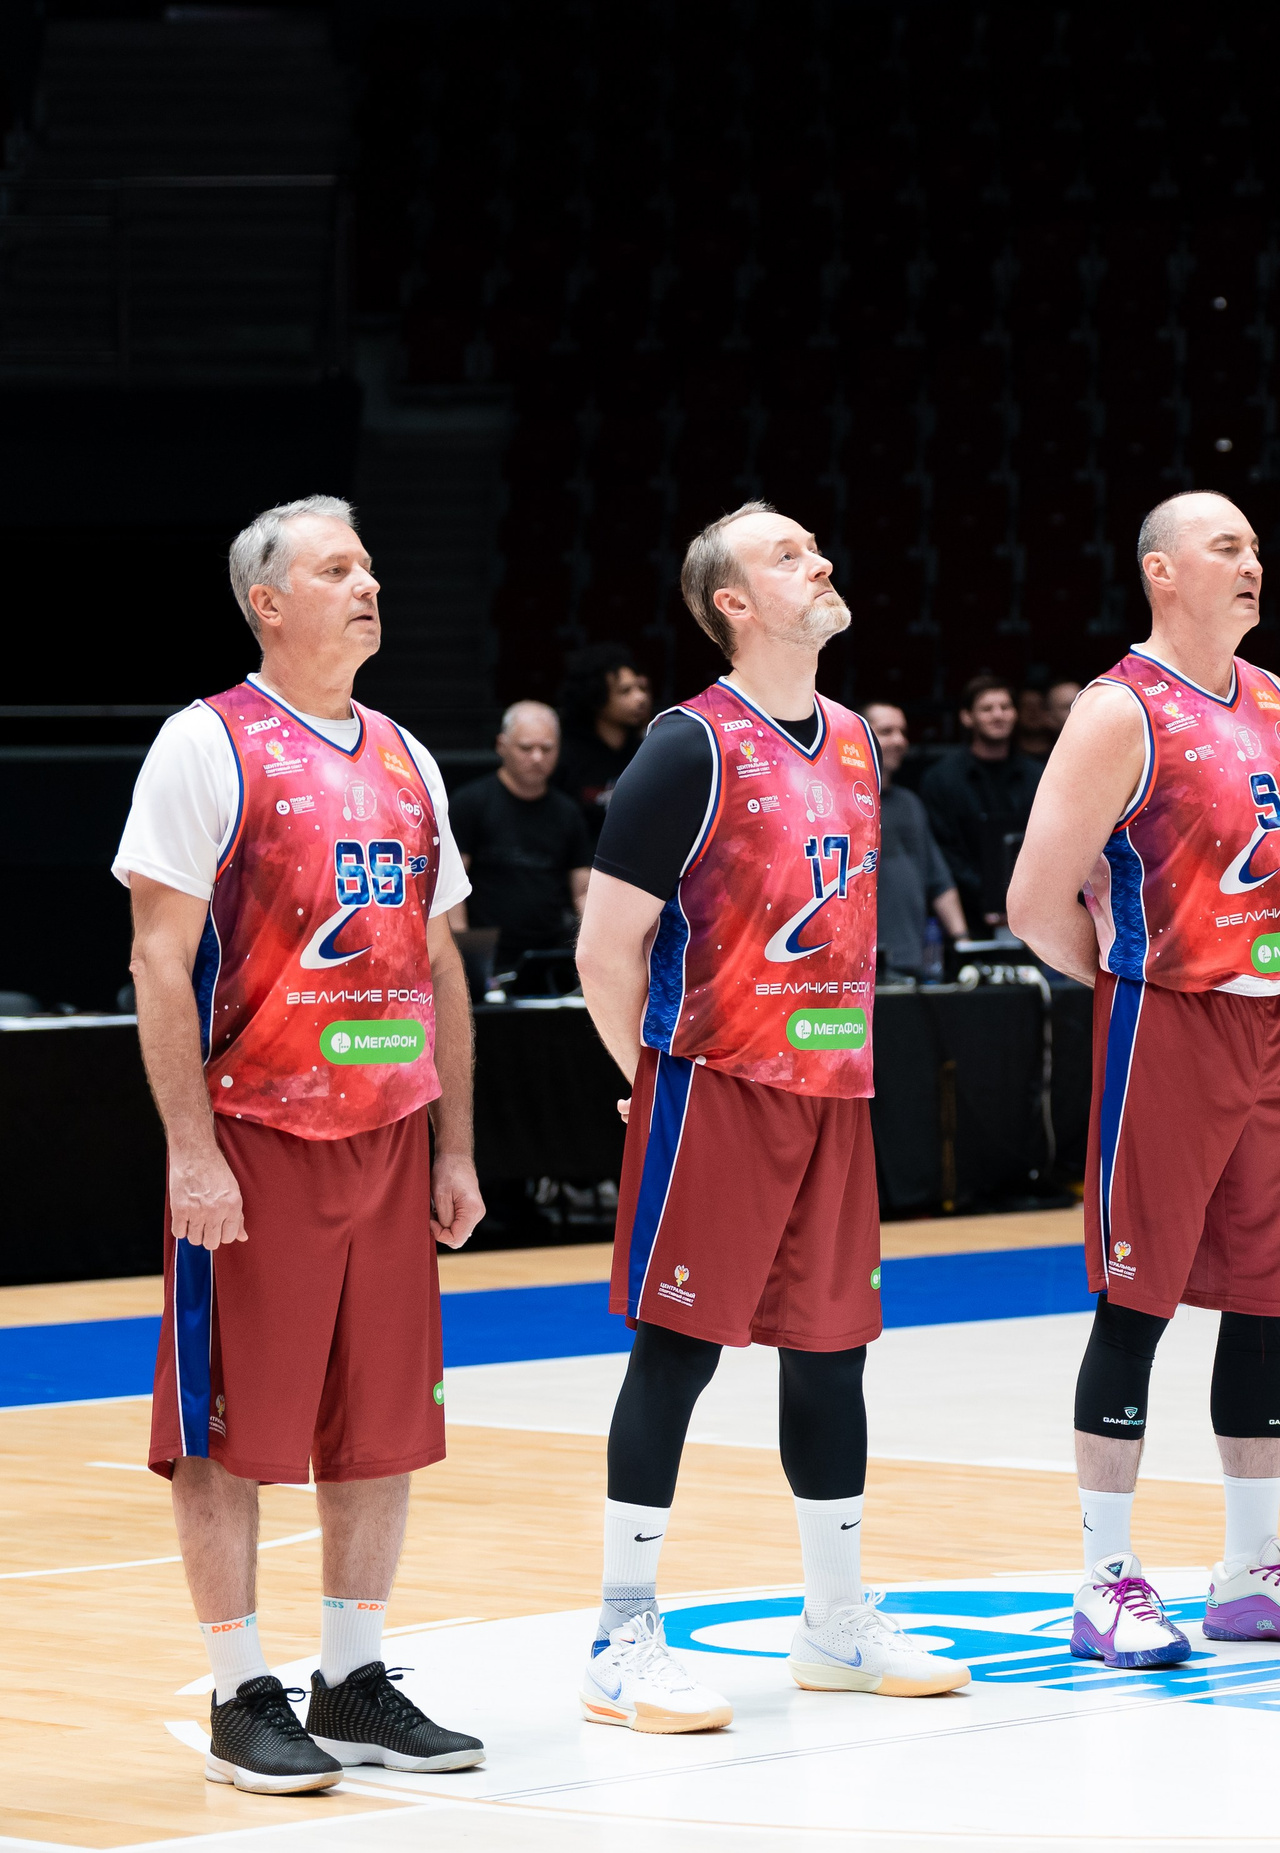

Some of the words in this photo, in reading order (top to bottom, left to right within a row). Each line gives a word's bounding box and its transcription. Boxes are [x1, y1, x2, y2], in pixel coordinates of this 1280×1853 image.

[1143, 681, 1169, 697] ZEDO
[244, 717, 281, 736] ZEDO
[720, 719, 753, 733] ZEDO
[400, 800, 420, 816] РФБ
[335, 838, 406, 908] 88
[804, 834, 851, 899] 17
[755, 981, 838, 995] ВЕЛИЧИЕ
[286, 989, 382, 1005] ВЕЛИЧИЕ
[357, 1602, 385, 1611] DDX
[211, 1619, 245, 1634] DDX
